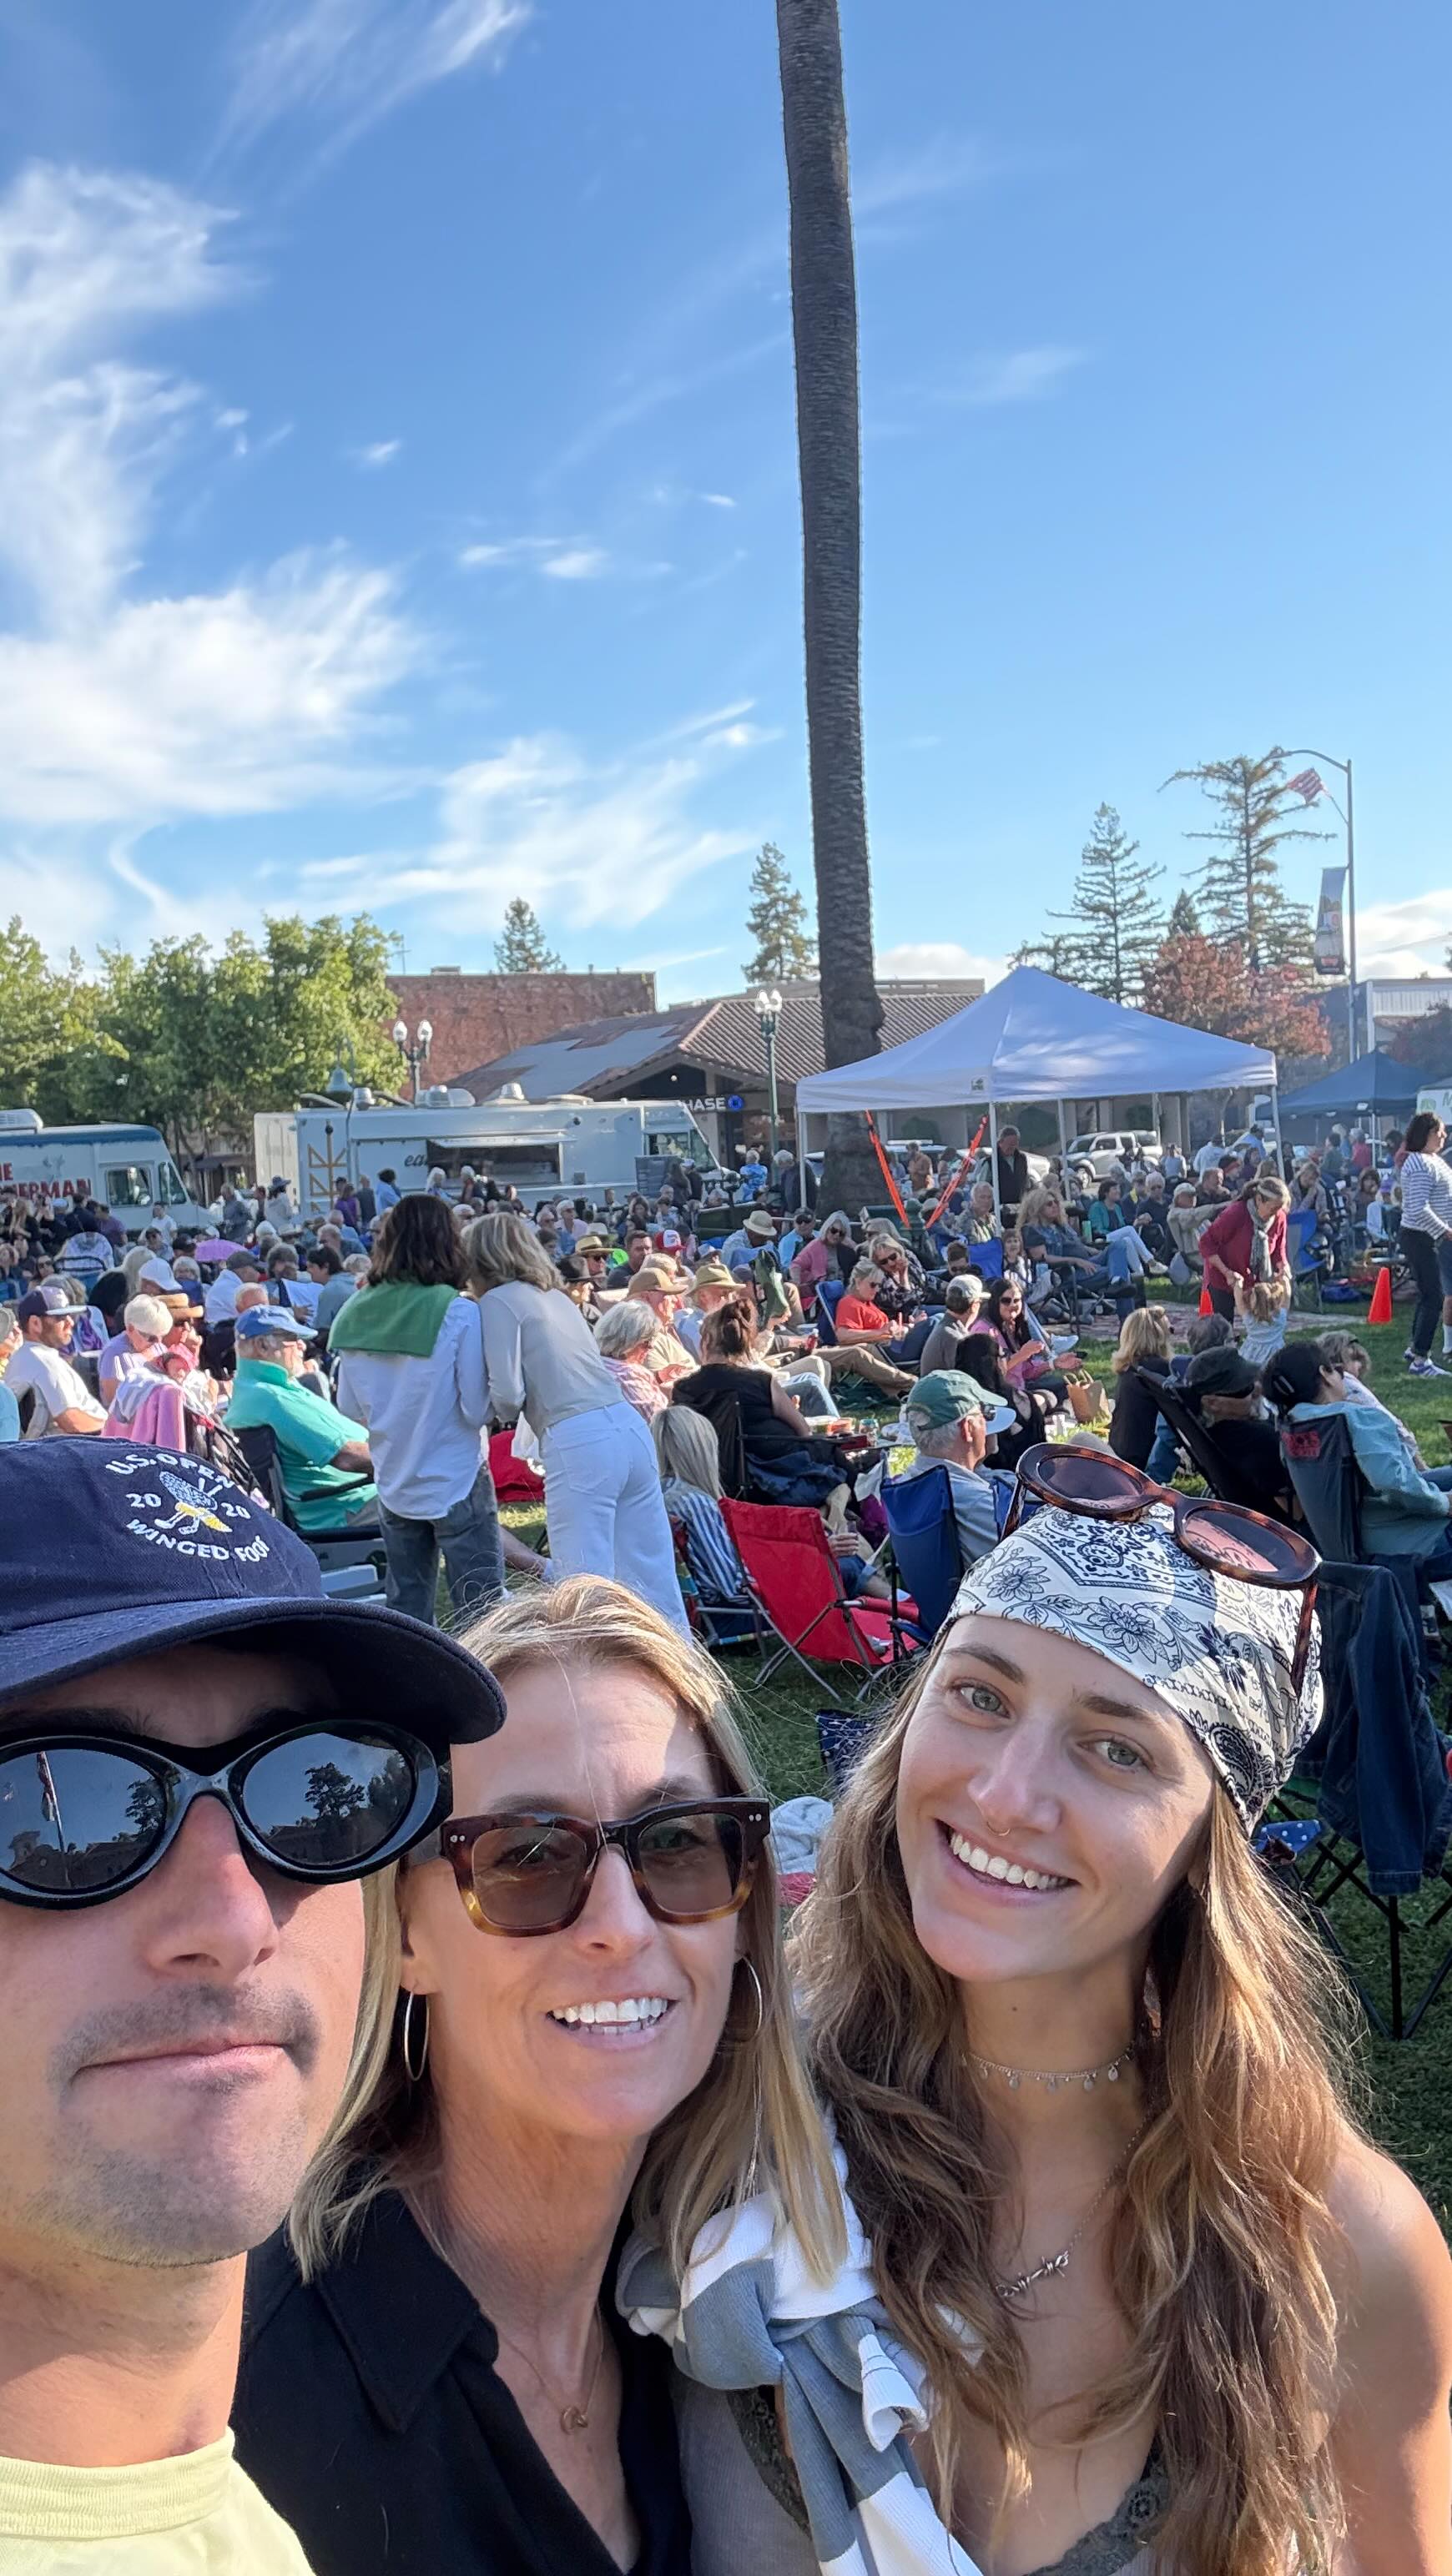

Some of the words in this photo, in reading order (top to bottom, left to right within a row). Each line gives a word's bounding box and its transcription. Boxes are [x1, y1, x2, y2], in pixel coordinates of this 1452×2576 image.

[684, 1096, 727, 1111] HASE
[105, 1454, 157, 1475] U.S.
[156, 1452, 234, 1488] OPEN
[125, 1492, 162, 1507] 20
[220, 1502, 251, 1519] 20
[126, 1518, 229, 1561] WINGED
[234, 1535, 270, 1562] FOOT
